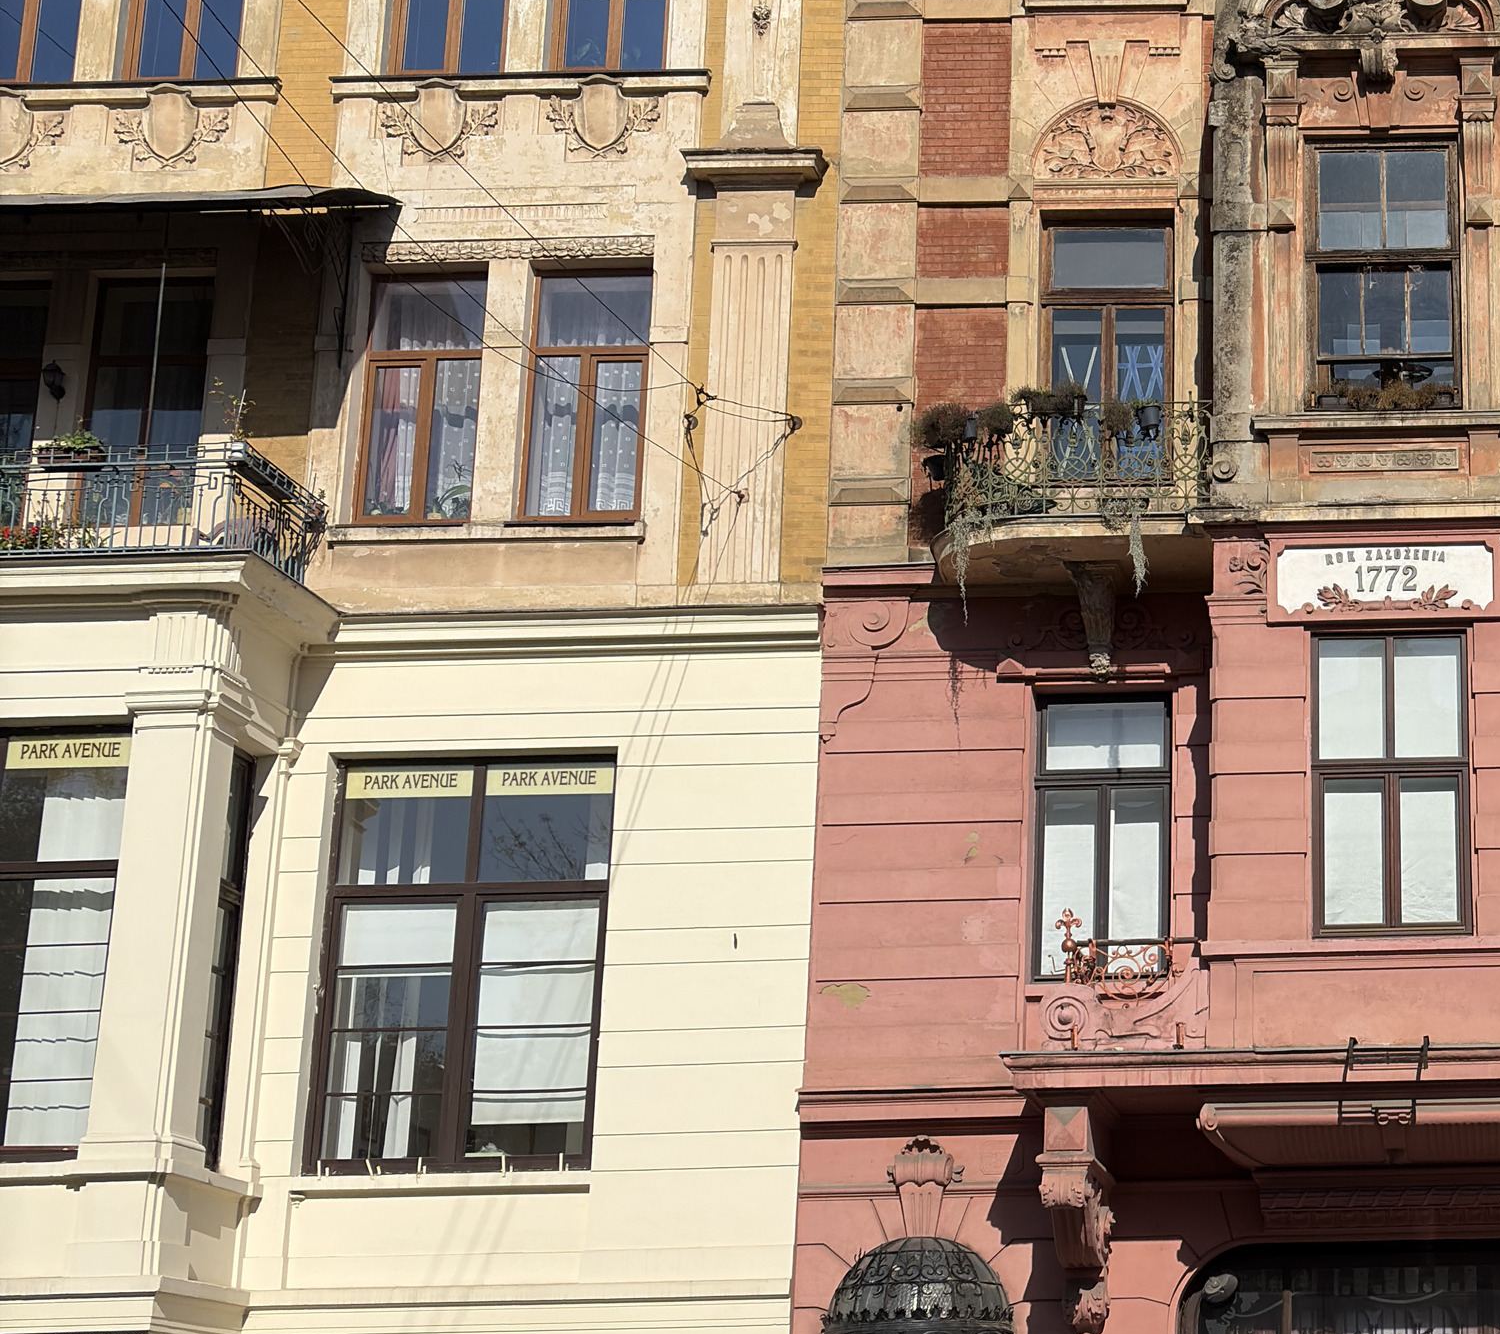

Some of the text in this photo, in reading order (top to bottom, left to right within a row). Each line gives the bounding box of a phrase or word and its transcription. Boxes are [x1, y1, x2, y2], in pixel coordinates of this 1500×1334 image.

[1325, 547, 1445, 565] ROK ZAŁOŻENIA
[1355, 565, 1418, 592] 1772
[20, 742, 121, 759] PARK AVENUE
[363, 773, 458, 789] PARK AVENUE
[502, 770, 597, 786] PARK AVENUE
